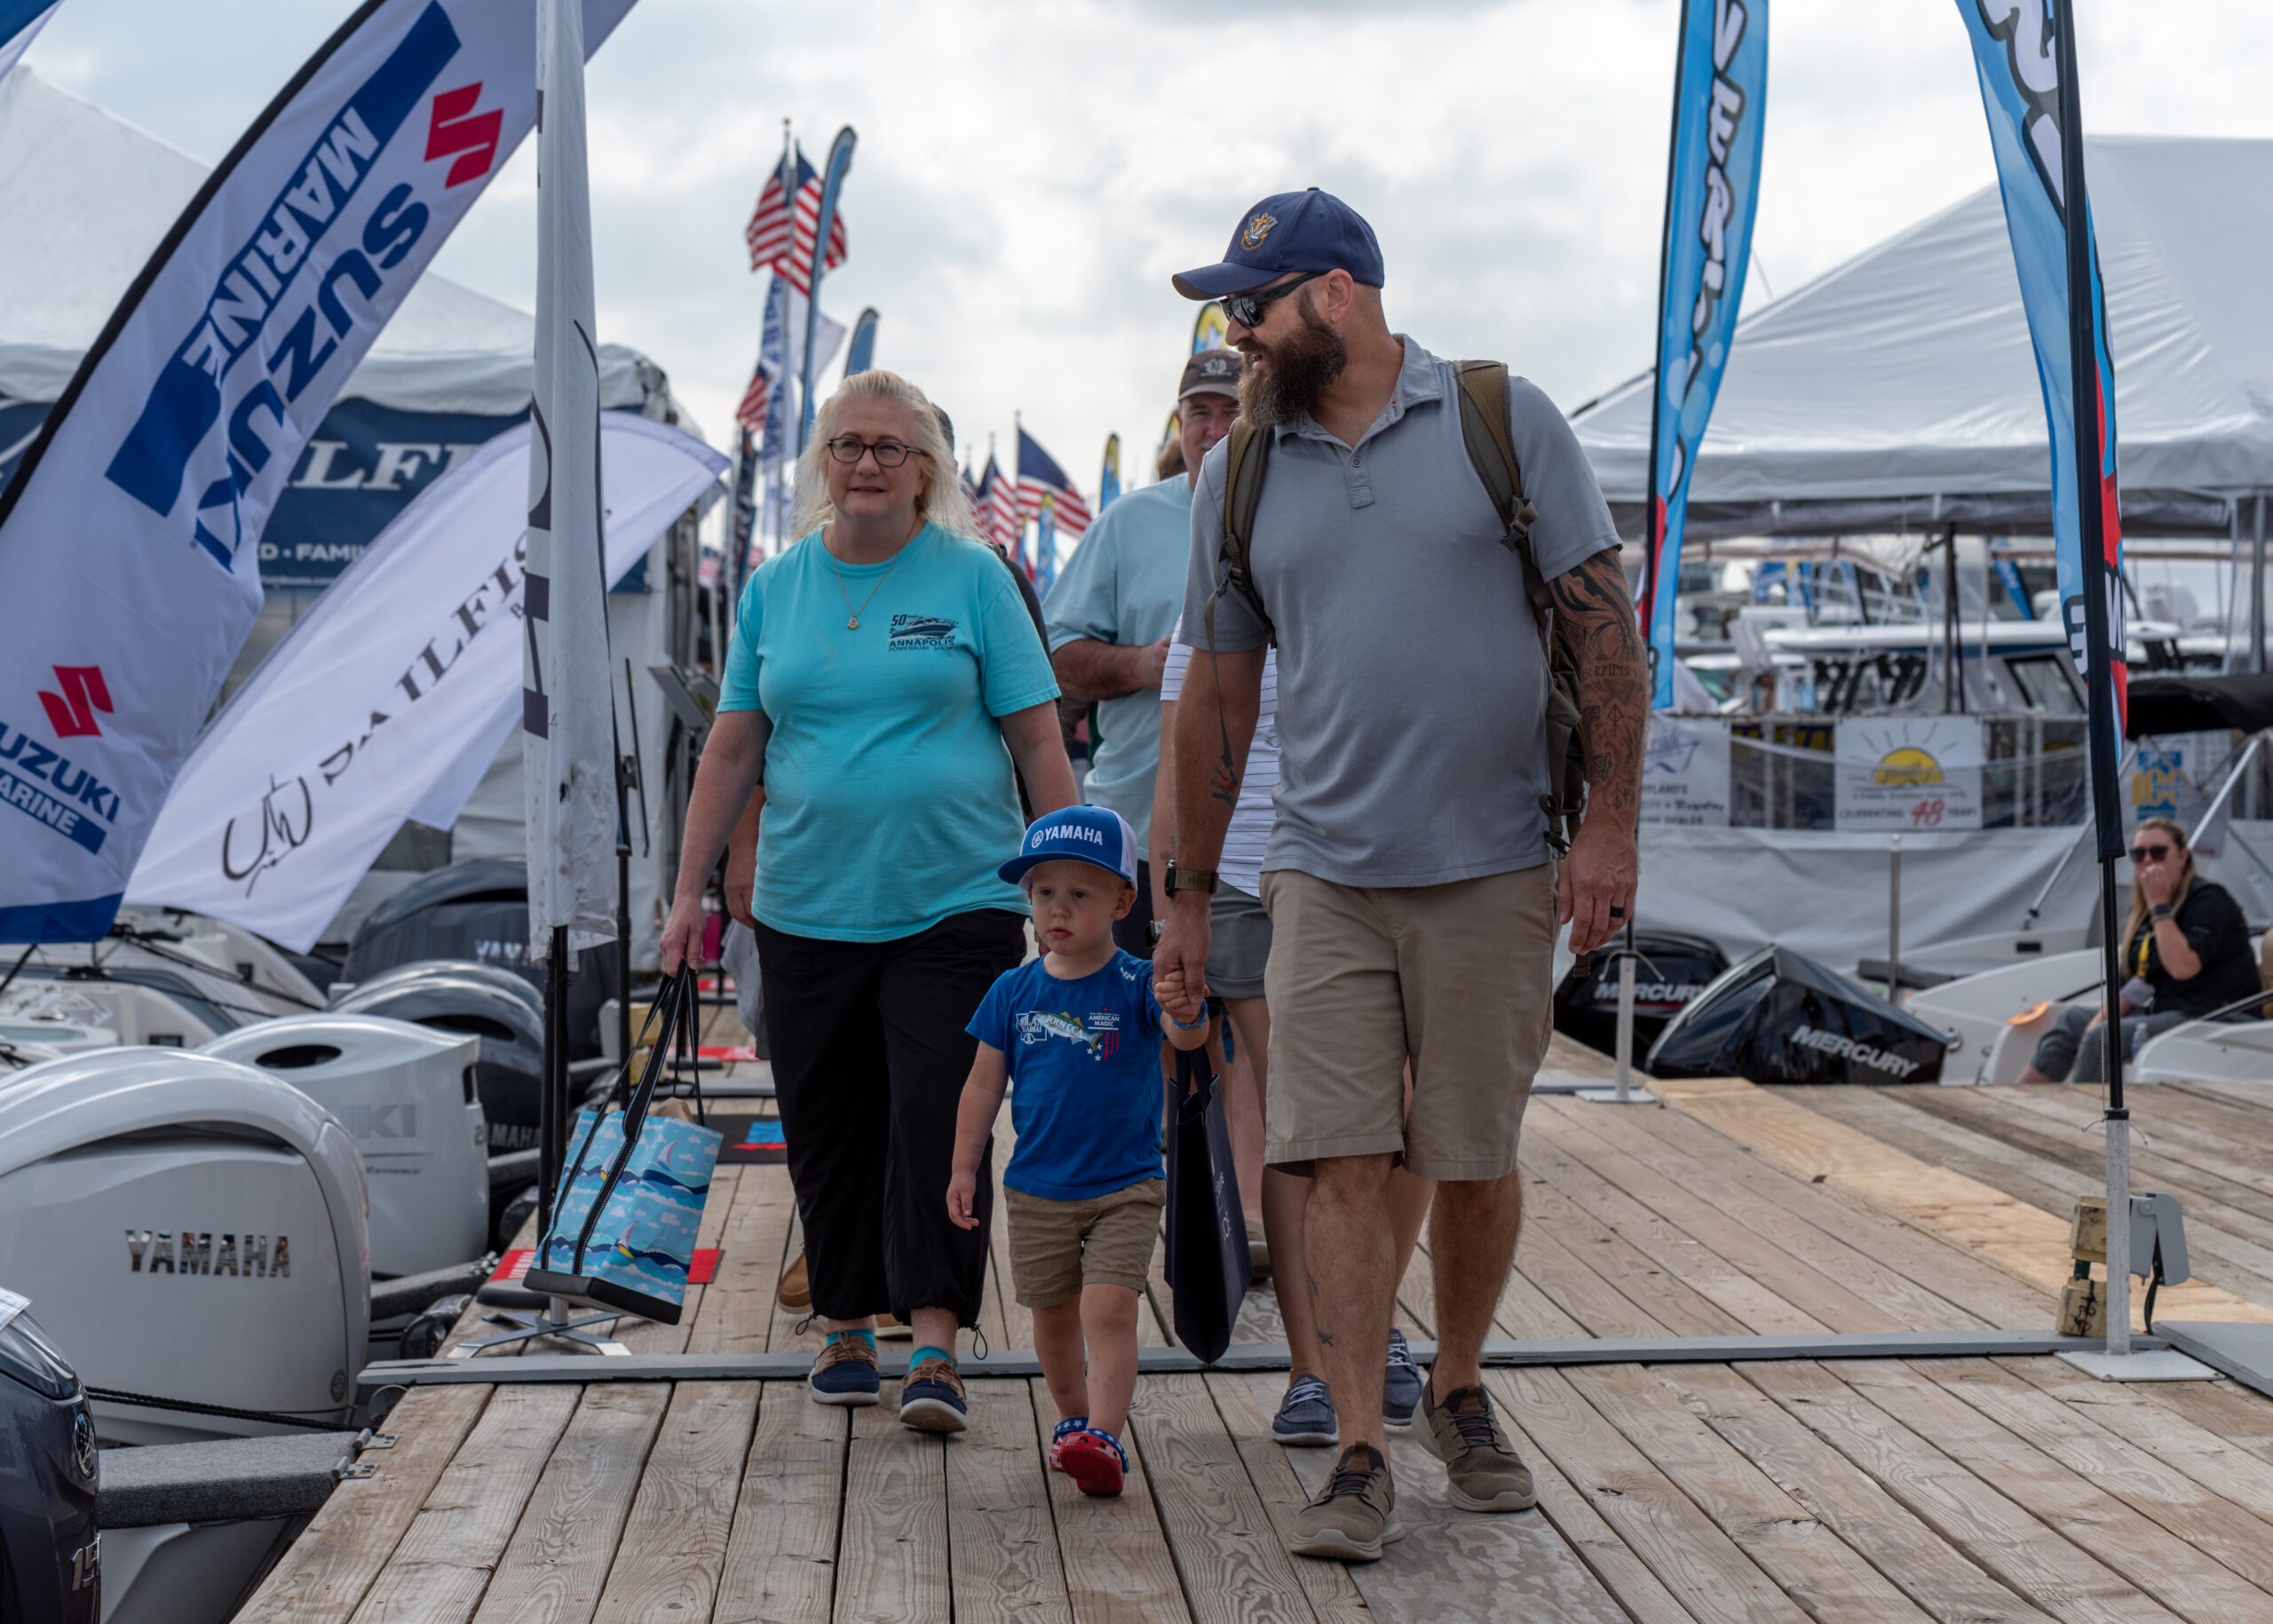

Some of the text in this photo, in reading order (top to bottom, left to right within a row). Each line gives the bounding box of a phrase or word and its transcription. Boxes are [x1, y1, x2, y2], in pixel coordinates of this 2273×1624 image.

[181, 107, 380, 389] MARINE
[193, 183, 430, 574] SUZUKI
[295, 543, 366, 561] FAMI
[891, 614, 907, 626] 50
[889, 638, 954, 647] ANNAPOLIS
[0, 721, 121, 825] UZUKI
[0, 772, 80, 836] ARINE
[1911, 798, 1944, 828] 48
[1045, 825, 1103, 845] YAMAHA
[1046, 1014, 1066, 1029] JOIN
[1791, 1024, 1920, 1078] MERCURY
[125, 1230, 291, 1278] YAMAHA
